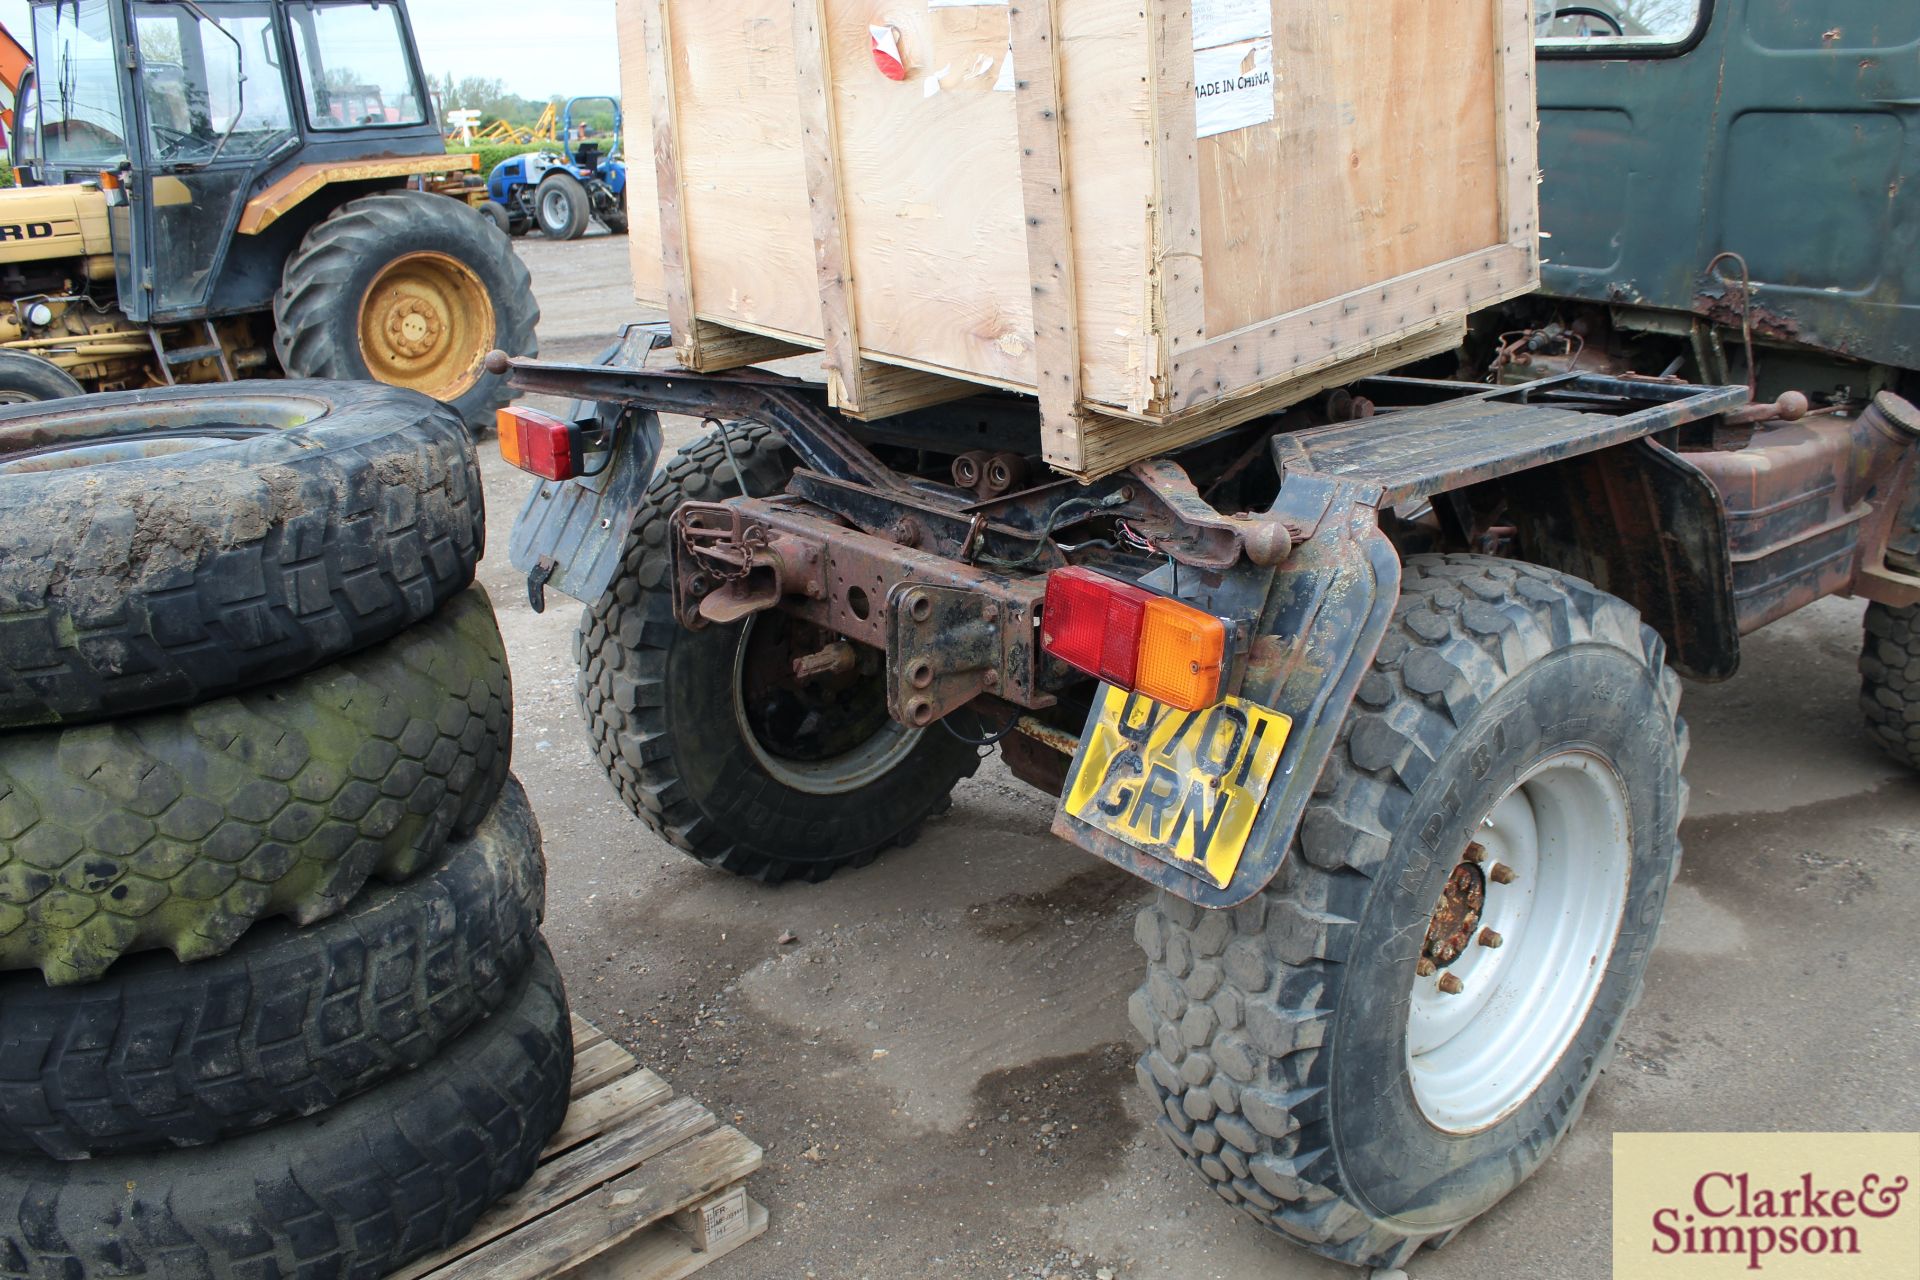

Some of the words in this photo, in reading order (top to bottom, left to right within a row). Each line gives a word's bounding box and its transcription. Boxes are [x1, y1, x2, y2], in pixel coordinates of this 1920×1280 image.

[1222, 79, 1235, 94] IN
[1237, 71, 1270, 89] CHINA
[1096, 748, 1230, 861] GRN
